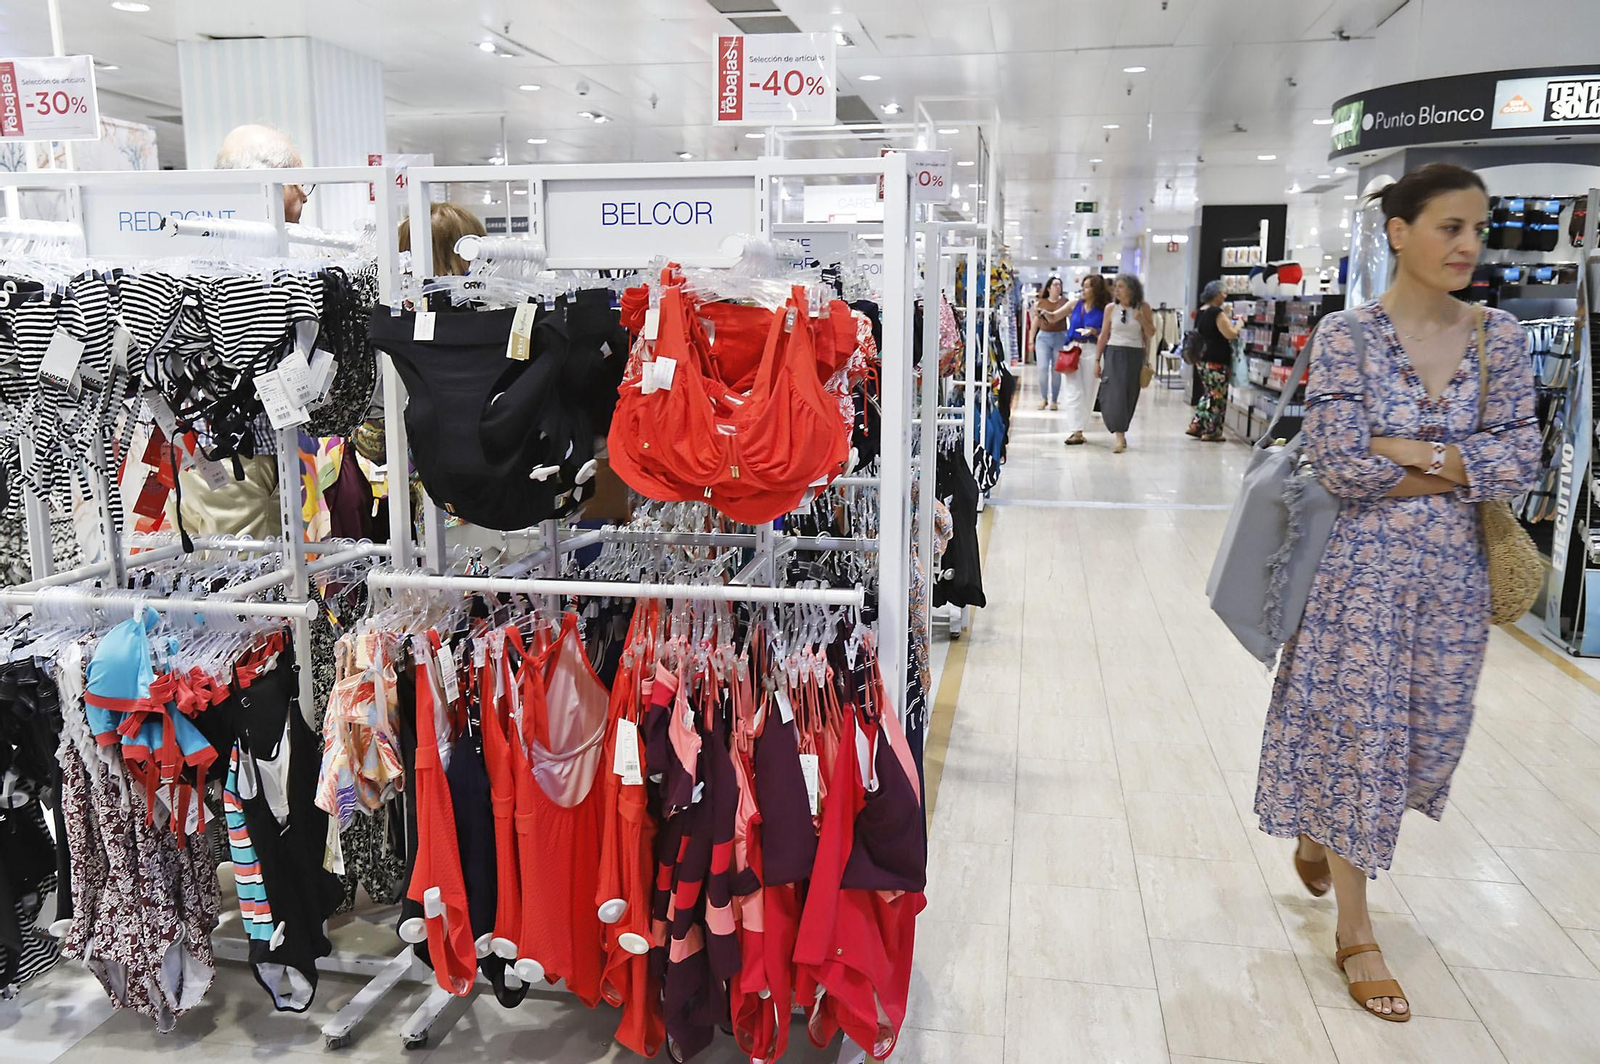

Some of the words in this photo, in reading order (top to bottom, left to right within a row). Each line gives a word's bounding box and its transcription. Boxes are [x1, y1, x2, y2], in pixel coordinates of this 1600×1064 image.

[749, 54, 782, 63] Selección
[22, 78, 50, 86] Selección
[722, 48, 740, 114] rebajas
[750, 70, 825, 96] -40%
[2, 74, 18, 132] rebajas
[26, 90, 88, 115] -30%
[1375, 112, 1416, 130] Punto
[1418, 104, 1484, 126] Blanco
[119, 212, 162, 231] RED
[602, 201, 712, 225] BELCOR
[1552, 443, 1575, 572] EJECUTIVO
